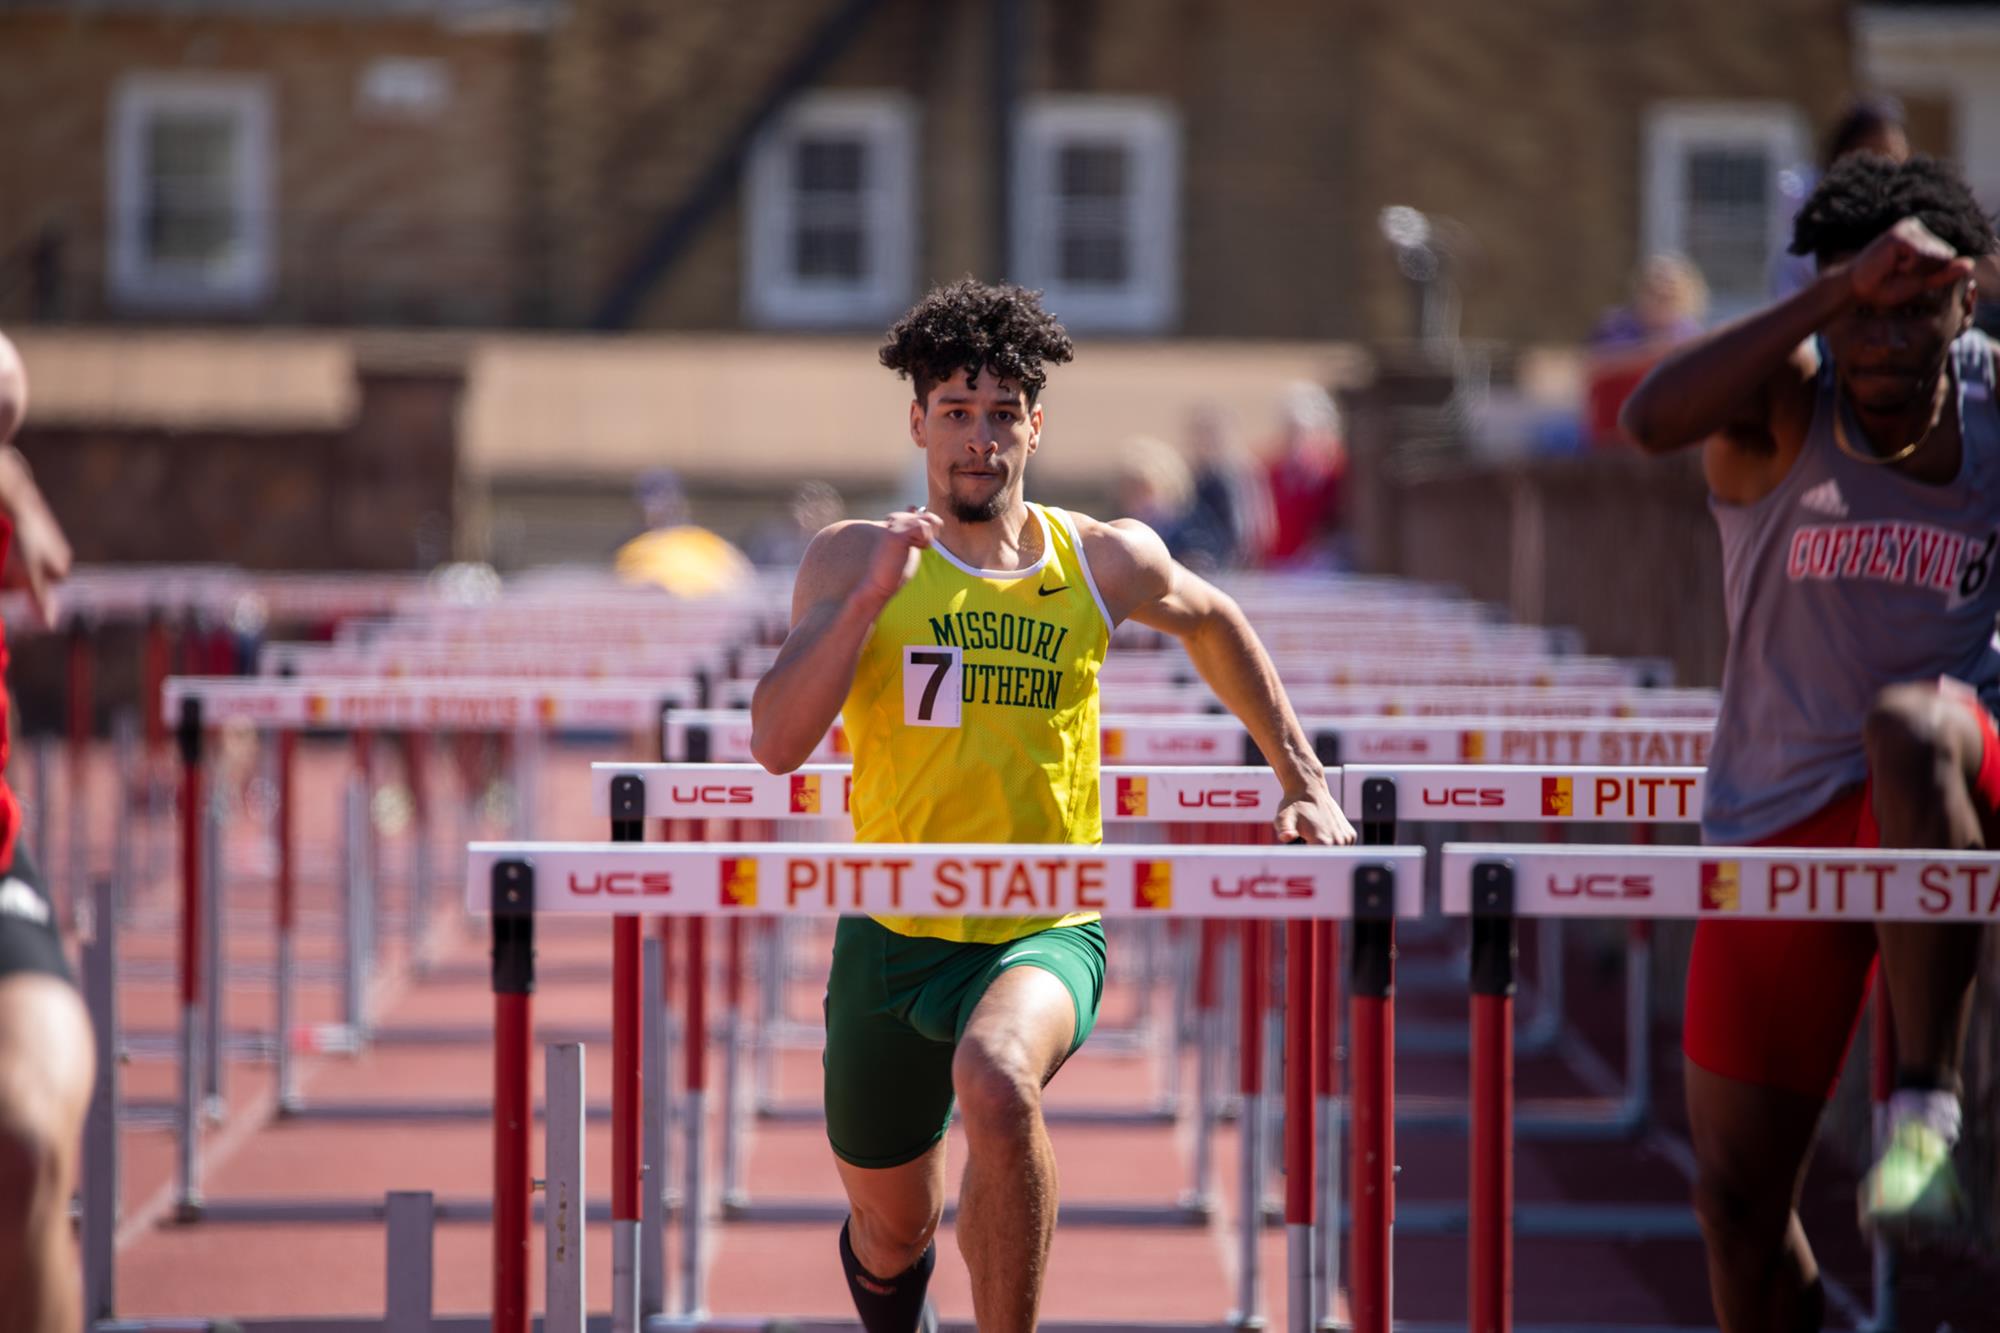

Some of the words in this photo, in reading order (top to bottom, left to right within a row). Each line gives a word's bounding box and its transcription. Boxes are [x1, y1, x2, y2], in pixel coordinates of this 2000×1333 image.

[1788, 523, 1983, 592] COFFEYVIL
[928, 612, 1068, 664] MISSOURI
[910, 652, 953, 721] 7
[961, 663, 1063, 710] UTHERN
[1500, 731, 1585, 766] PITT
[671, 785, 754, 805] UCS
[1177, 788, 1261, 809] UCS
[1422, 787, 1506, 808] UCS
[1594, 777, 1697, 818] PITT
[567, 871, 673, 897] UCS
[785, 858, 913, 909] PITT
[932, 857, 1107, 910] STATE
[1211, 871, 1317, 900] UCS
[1547, 873, 1655, 900] UCS
[1767, 861, 1898, 914] PITT
